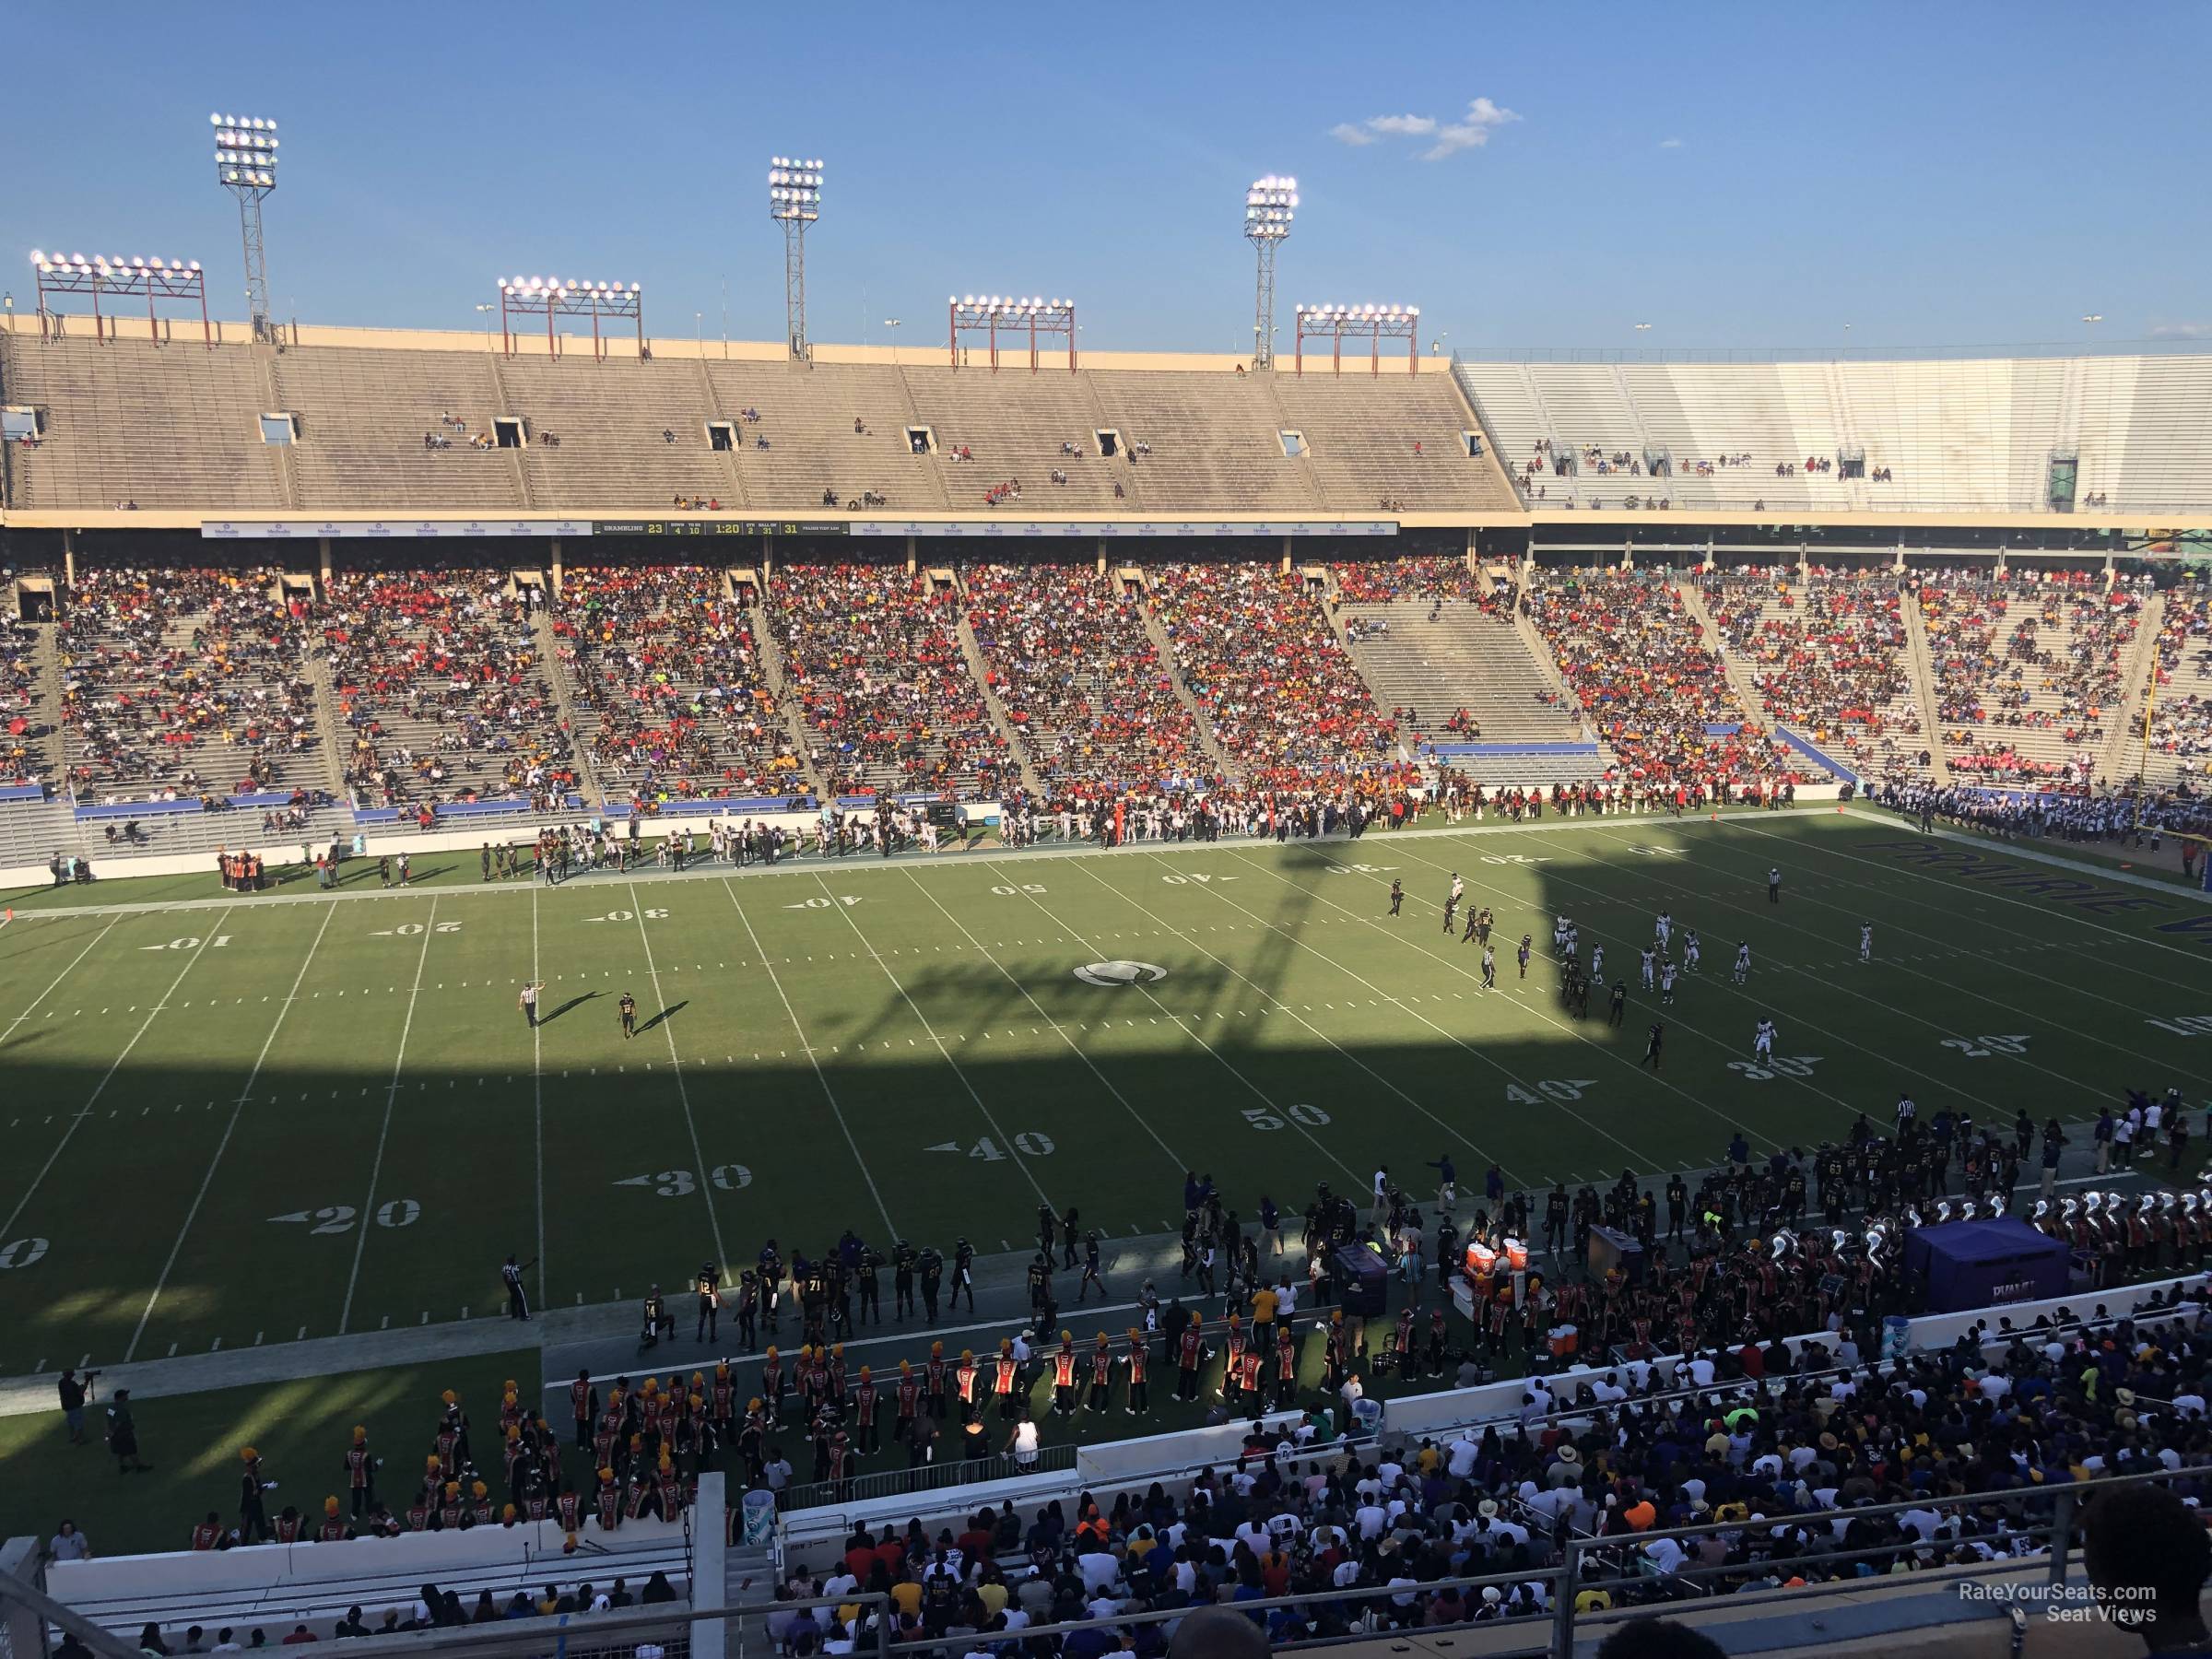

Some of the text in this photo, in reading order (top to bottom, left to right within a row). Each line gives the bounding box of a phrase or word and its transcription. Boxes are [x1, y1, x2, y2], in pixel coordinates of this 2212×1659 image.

[648, 524, 663, 534] 23
[715, 524, 739, 534] 1:20
[784, 524, 797, 534] 31
[1628, 845, 1670, 855] 10
[1479, 854, 1535, 865] 20
[1324, 864, 1377, 875] 30
[1162, 873, 1211, 886] 40
[991, 884, 1047, 896] 50
[805, 895, 863, 909] 40
[607, 908, 671, 922] 30
[396, 921, 463, 936] 20
[168, 935, 232, 950] 10
[1940, 1035, 2016, 1057] 20
[1726, 1054, 1810, 1081] 30
[1508, 1079, 1582, 1104] 40
[1241, 1104, 1330, 1130] 50
[969, 1131, 1055, 1162] 40
[655, 1163, 752, 1197] 30
[310, 1198, 421, 1234] 20
